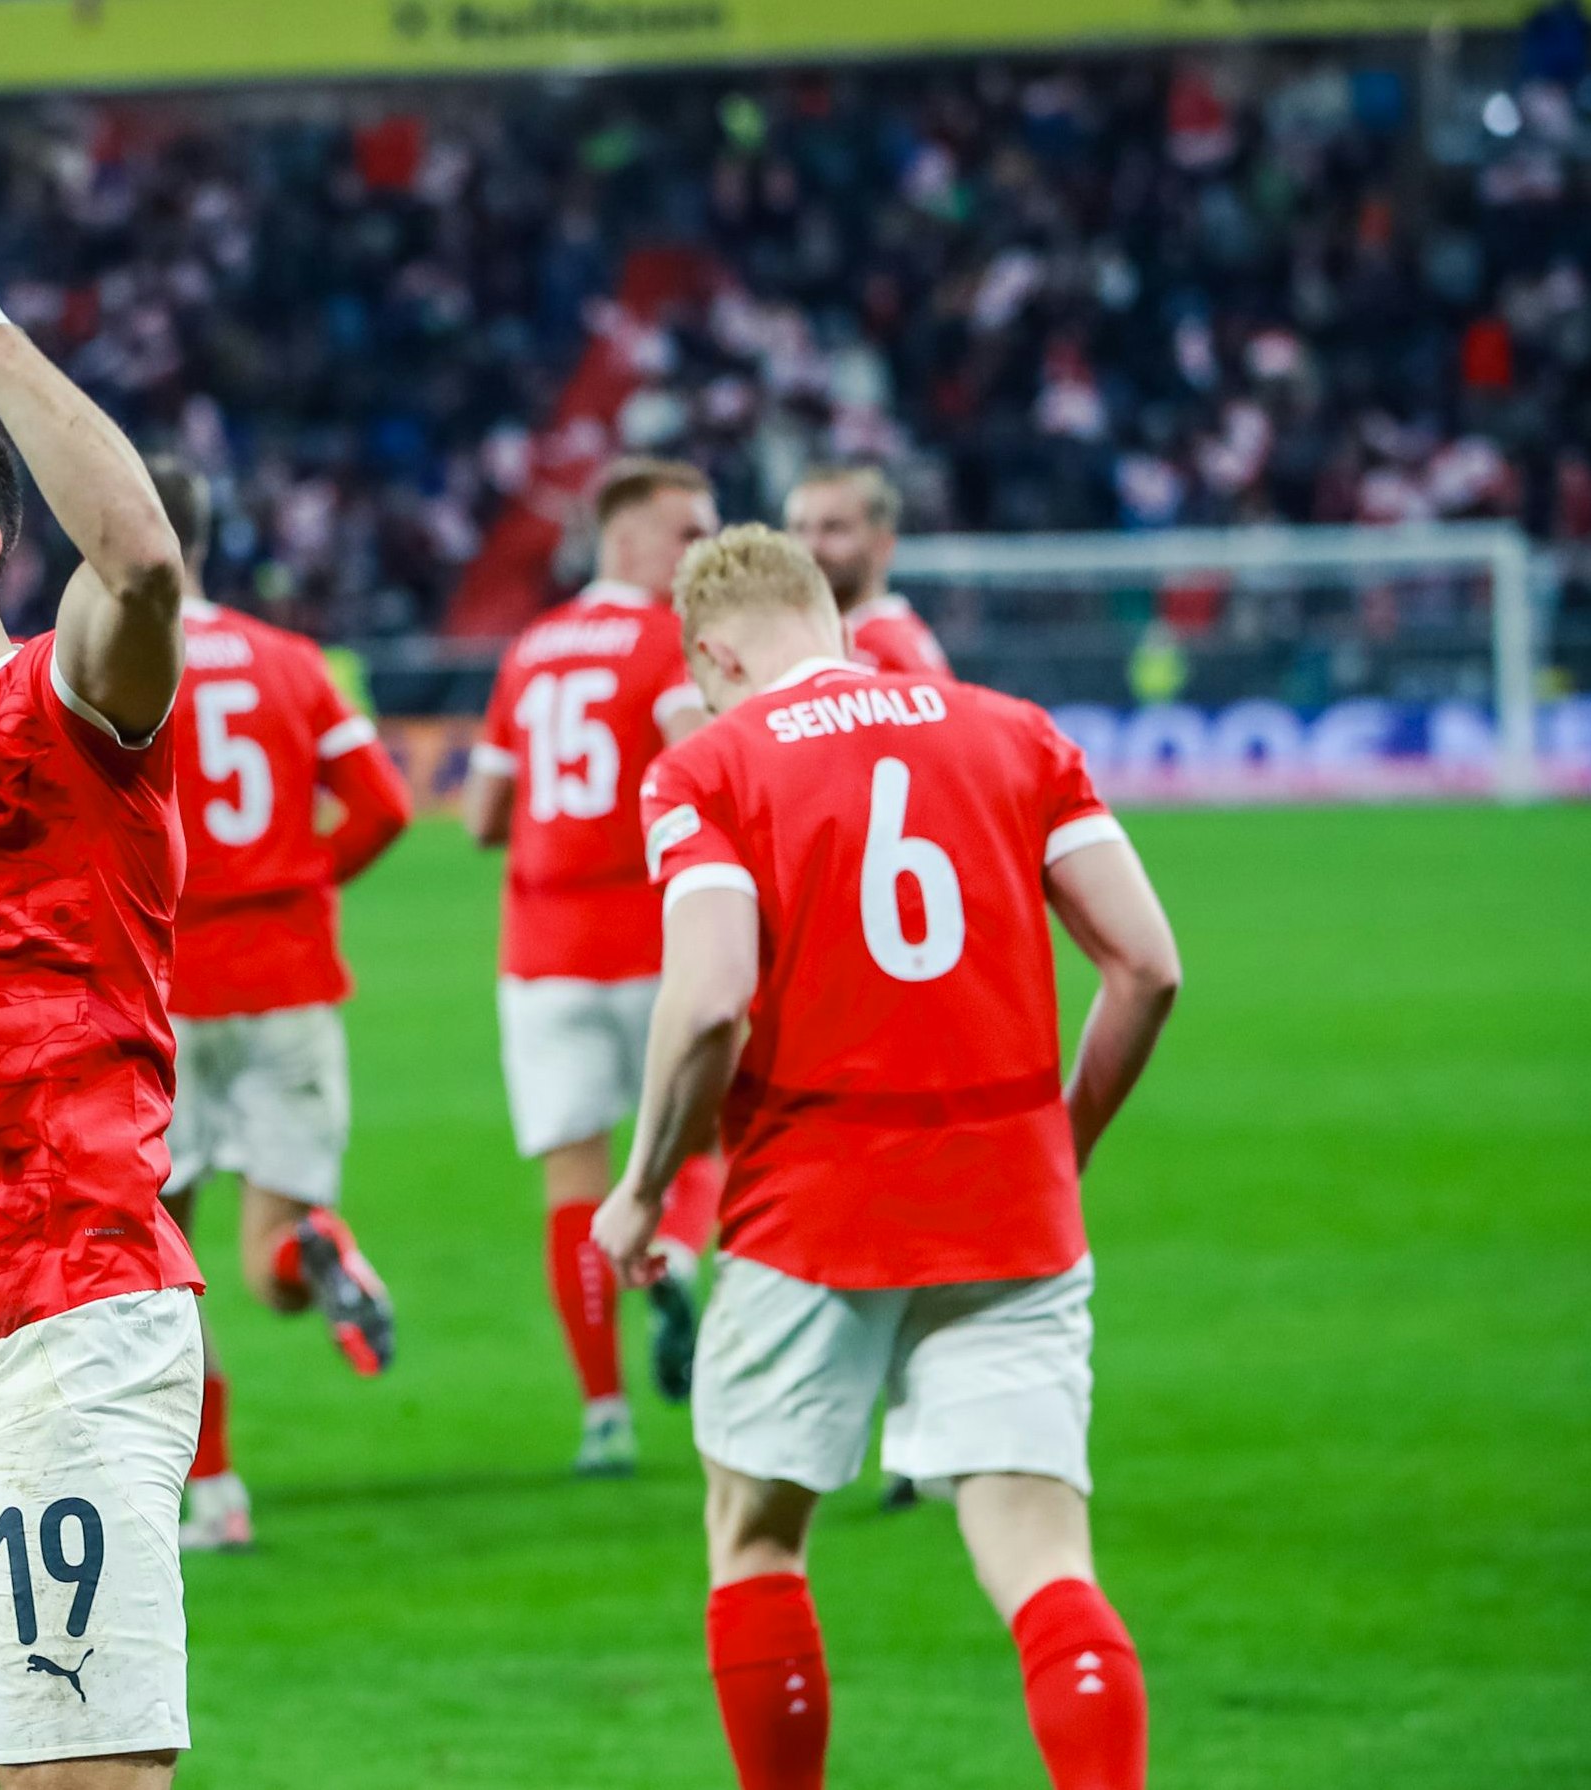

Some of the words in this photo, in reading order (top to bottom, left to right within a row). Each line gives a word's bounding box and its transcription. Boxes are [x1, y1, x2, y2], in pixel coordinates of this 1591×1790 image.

[193, 680, 274, 847] 5
[514, 667, 620, 823] 15
[766, 684, 947, 743] SEIWALD
[860, 756, 965, 982] 6
